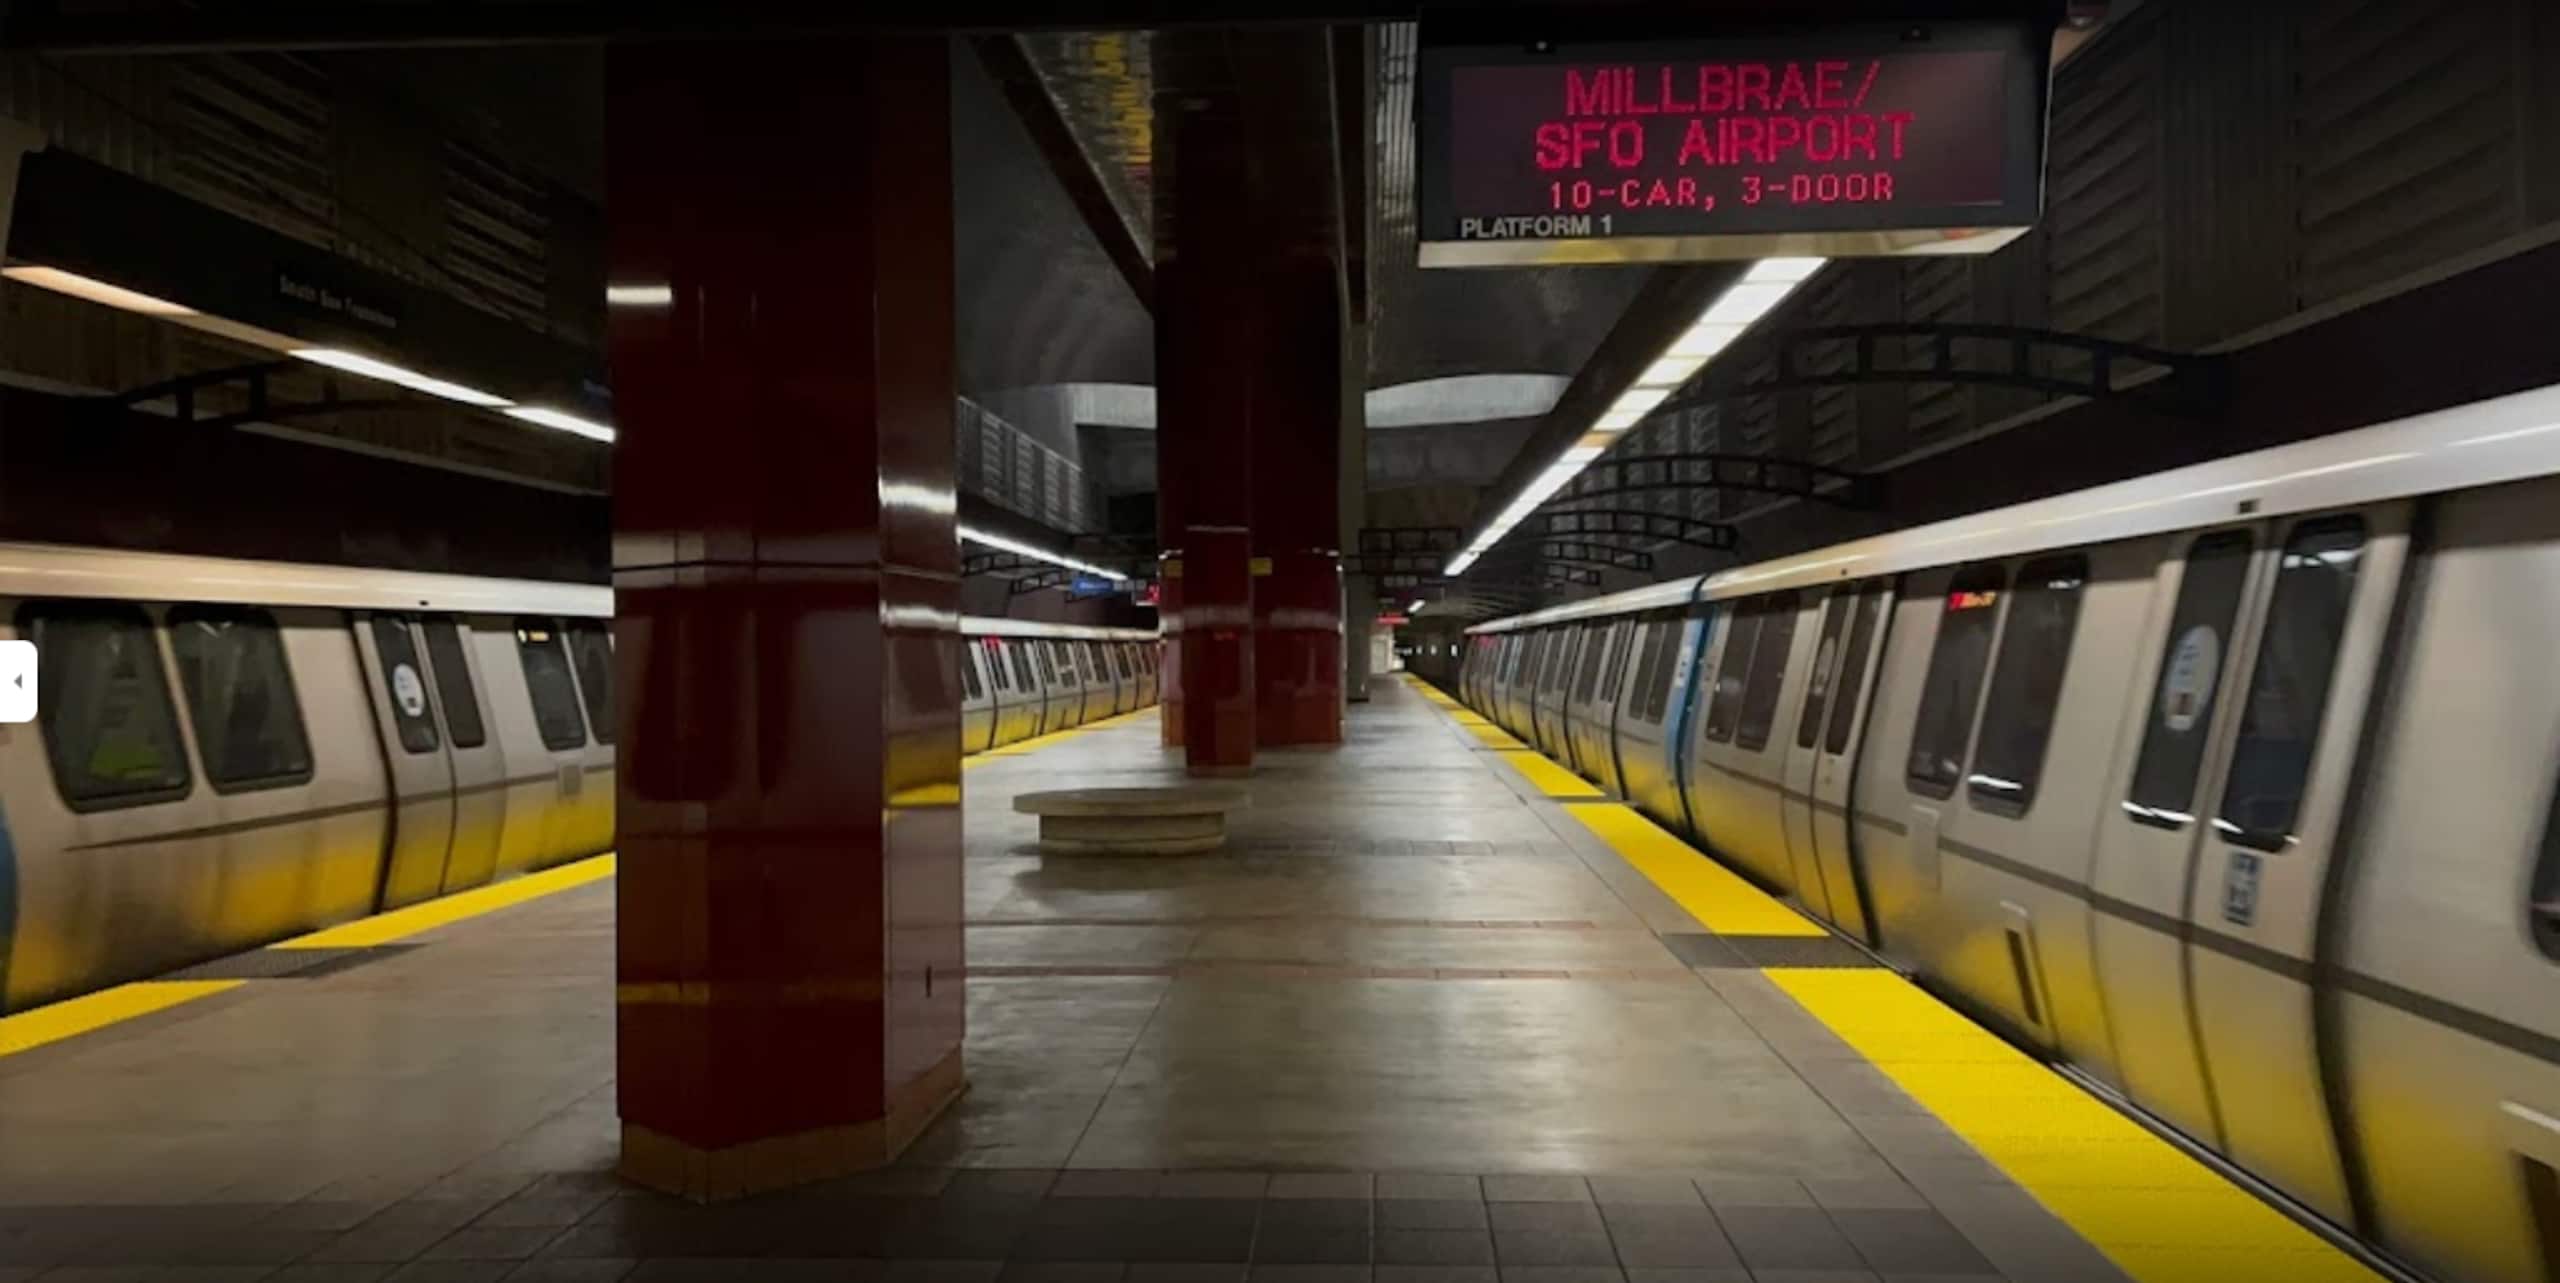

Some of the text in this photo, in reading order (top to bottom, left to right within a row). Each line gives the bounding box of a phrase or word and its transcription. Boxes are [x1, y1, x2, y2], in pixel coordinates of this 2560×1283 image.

[1565, 60, 1881, 116] MILLBRAE/
[1535, 111, 1916, 171] SFO AIRPORT
[1551, 171, 1894, 212] 10-CAR, 3-DOOR
[1460, 214, 1613, 239] PLATFORM 1
